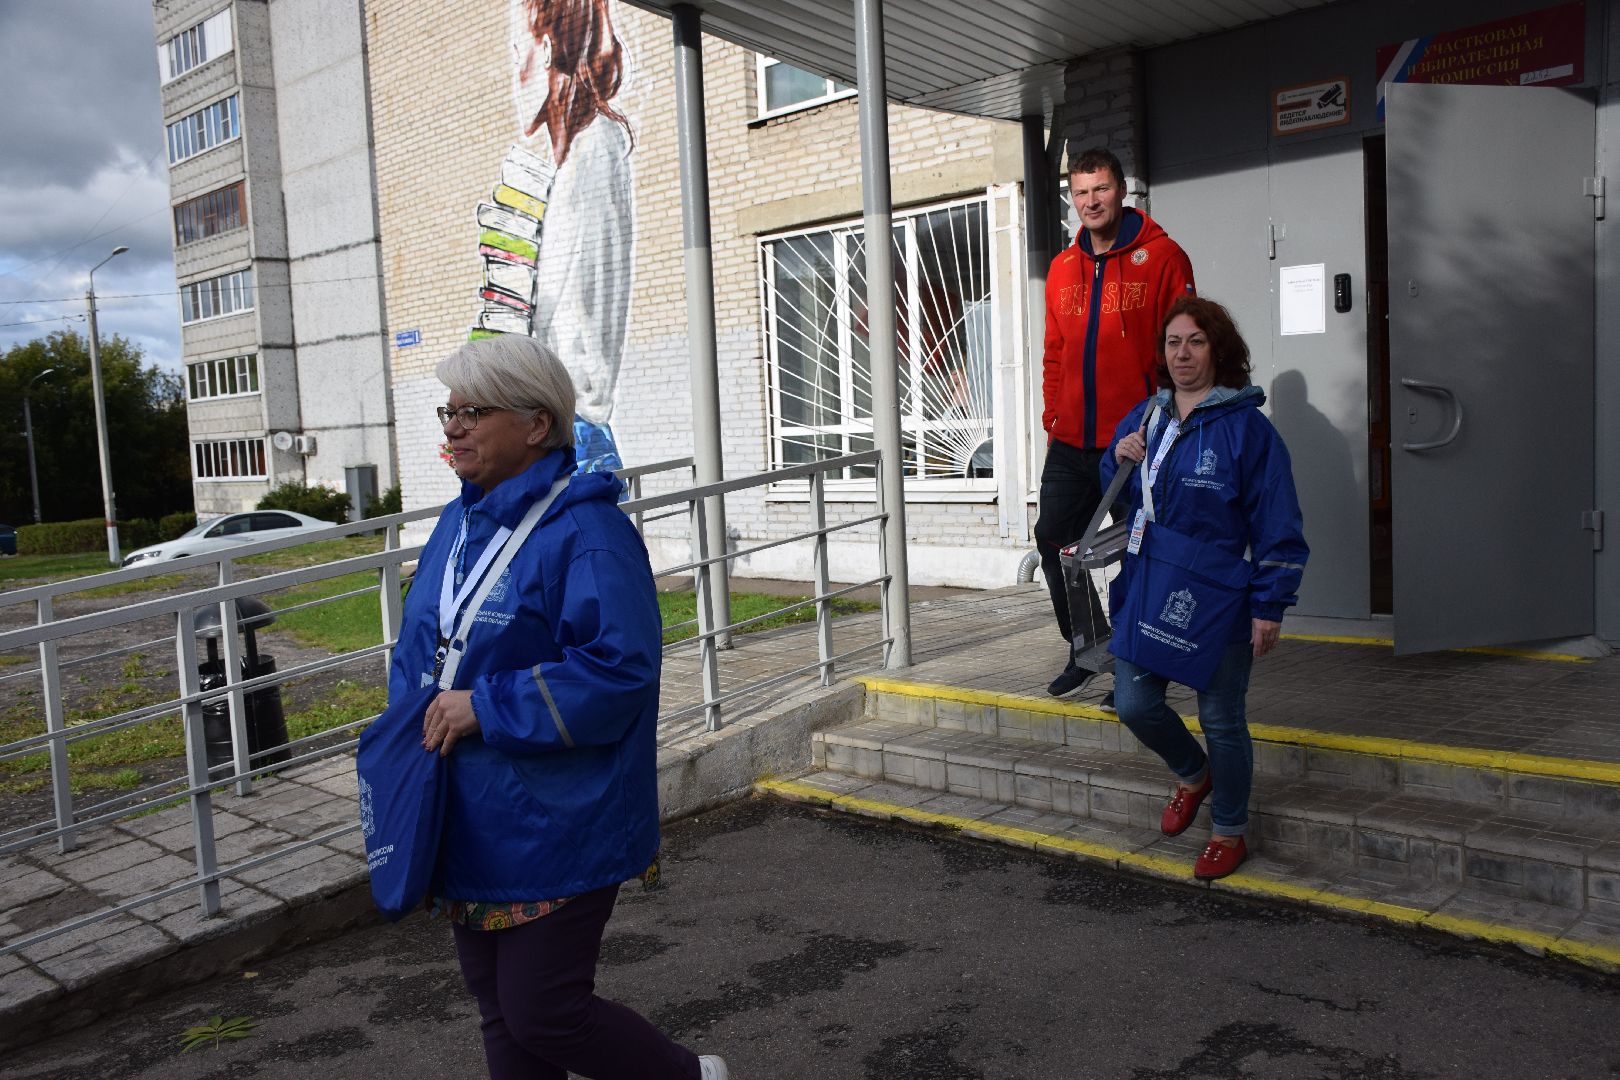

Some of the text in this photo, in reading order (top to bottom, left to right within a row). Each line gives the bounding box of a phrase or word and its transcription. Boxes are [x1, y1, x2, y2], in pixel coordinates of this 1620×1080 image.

[1407, 36, 1544, 76] ИЗБИРАТЕЛЬНАЯ
[1423, 23, 1528, 57] УЧАСТКОВАЯ
[1431, 59, 1520, 84] КОМИССИЯ
